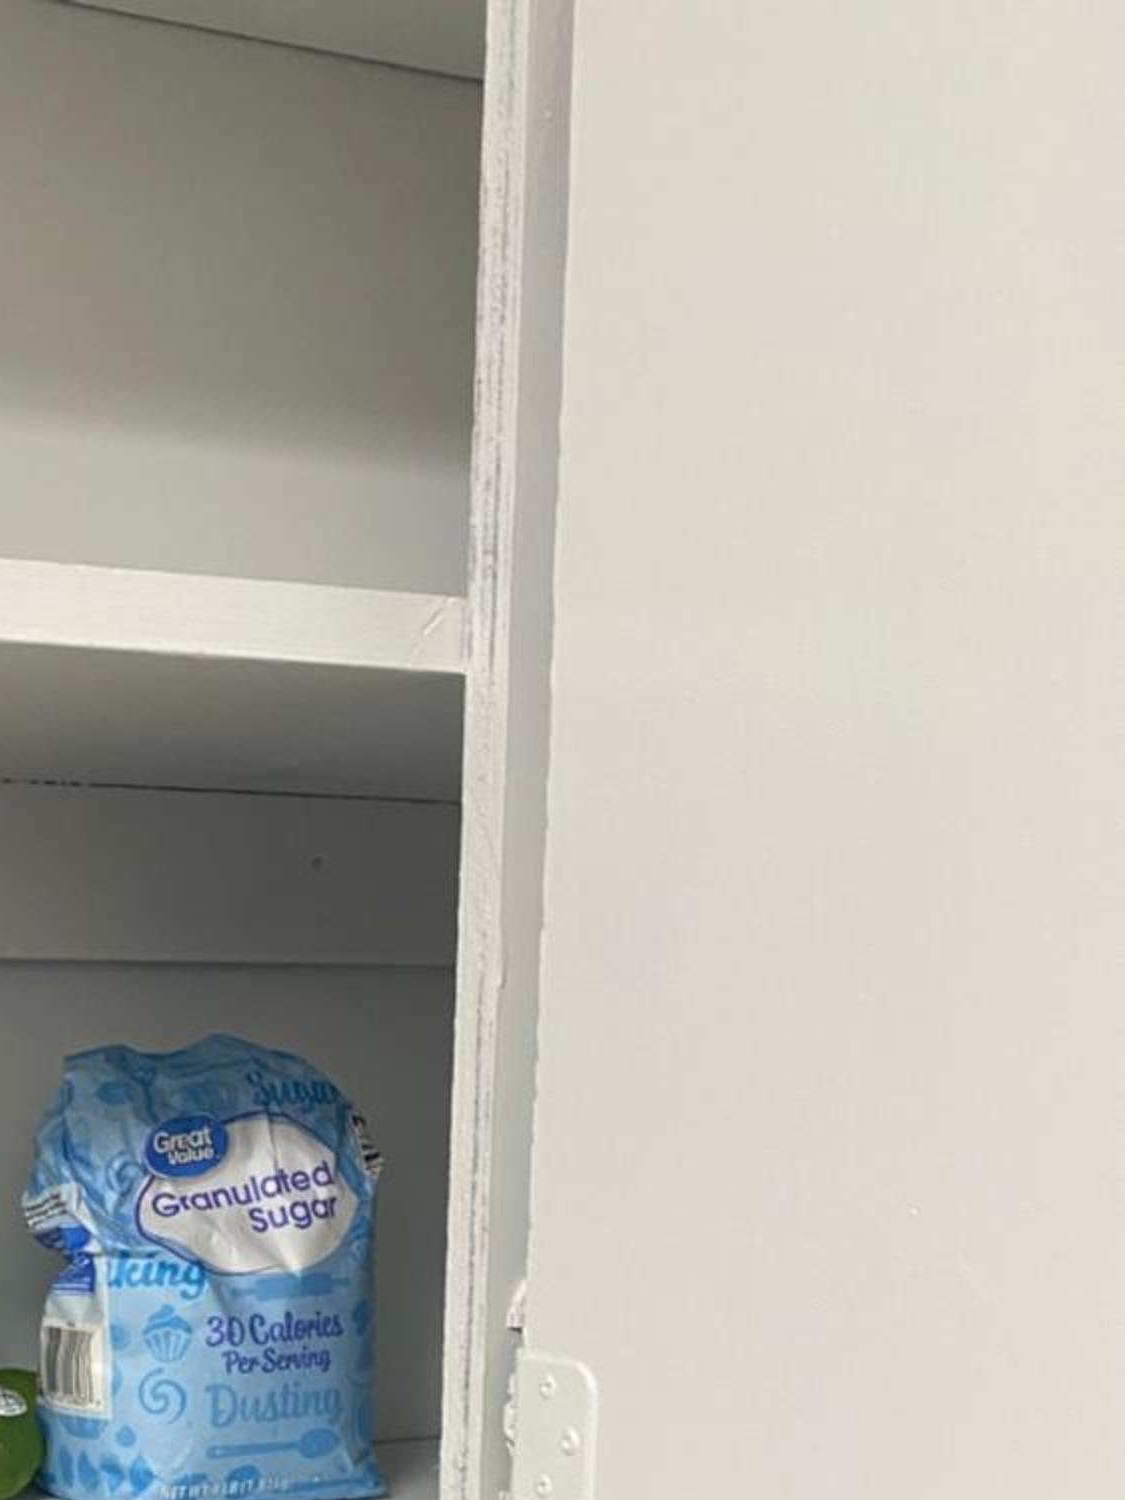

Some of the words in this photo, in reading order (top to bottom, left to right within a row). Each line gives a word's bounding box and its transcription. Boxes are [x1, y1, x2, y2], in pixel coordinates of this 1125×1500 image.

[153, 1126, 212, 1152] Great
[166, 1147, 213, 1165] Value
[151, 1161, 335, 1217] Granulated
[249, 1196, 338, 1234] Sugar
[205, 1315, 245, 1347] 30
[249, 1311, 345, 1346] Calories
[222, 1351, 261, 1374] Per
[261, 1348, 332, 1373] Serving
[204, 1377, 345, 1428] Dusting
